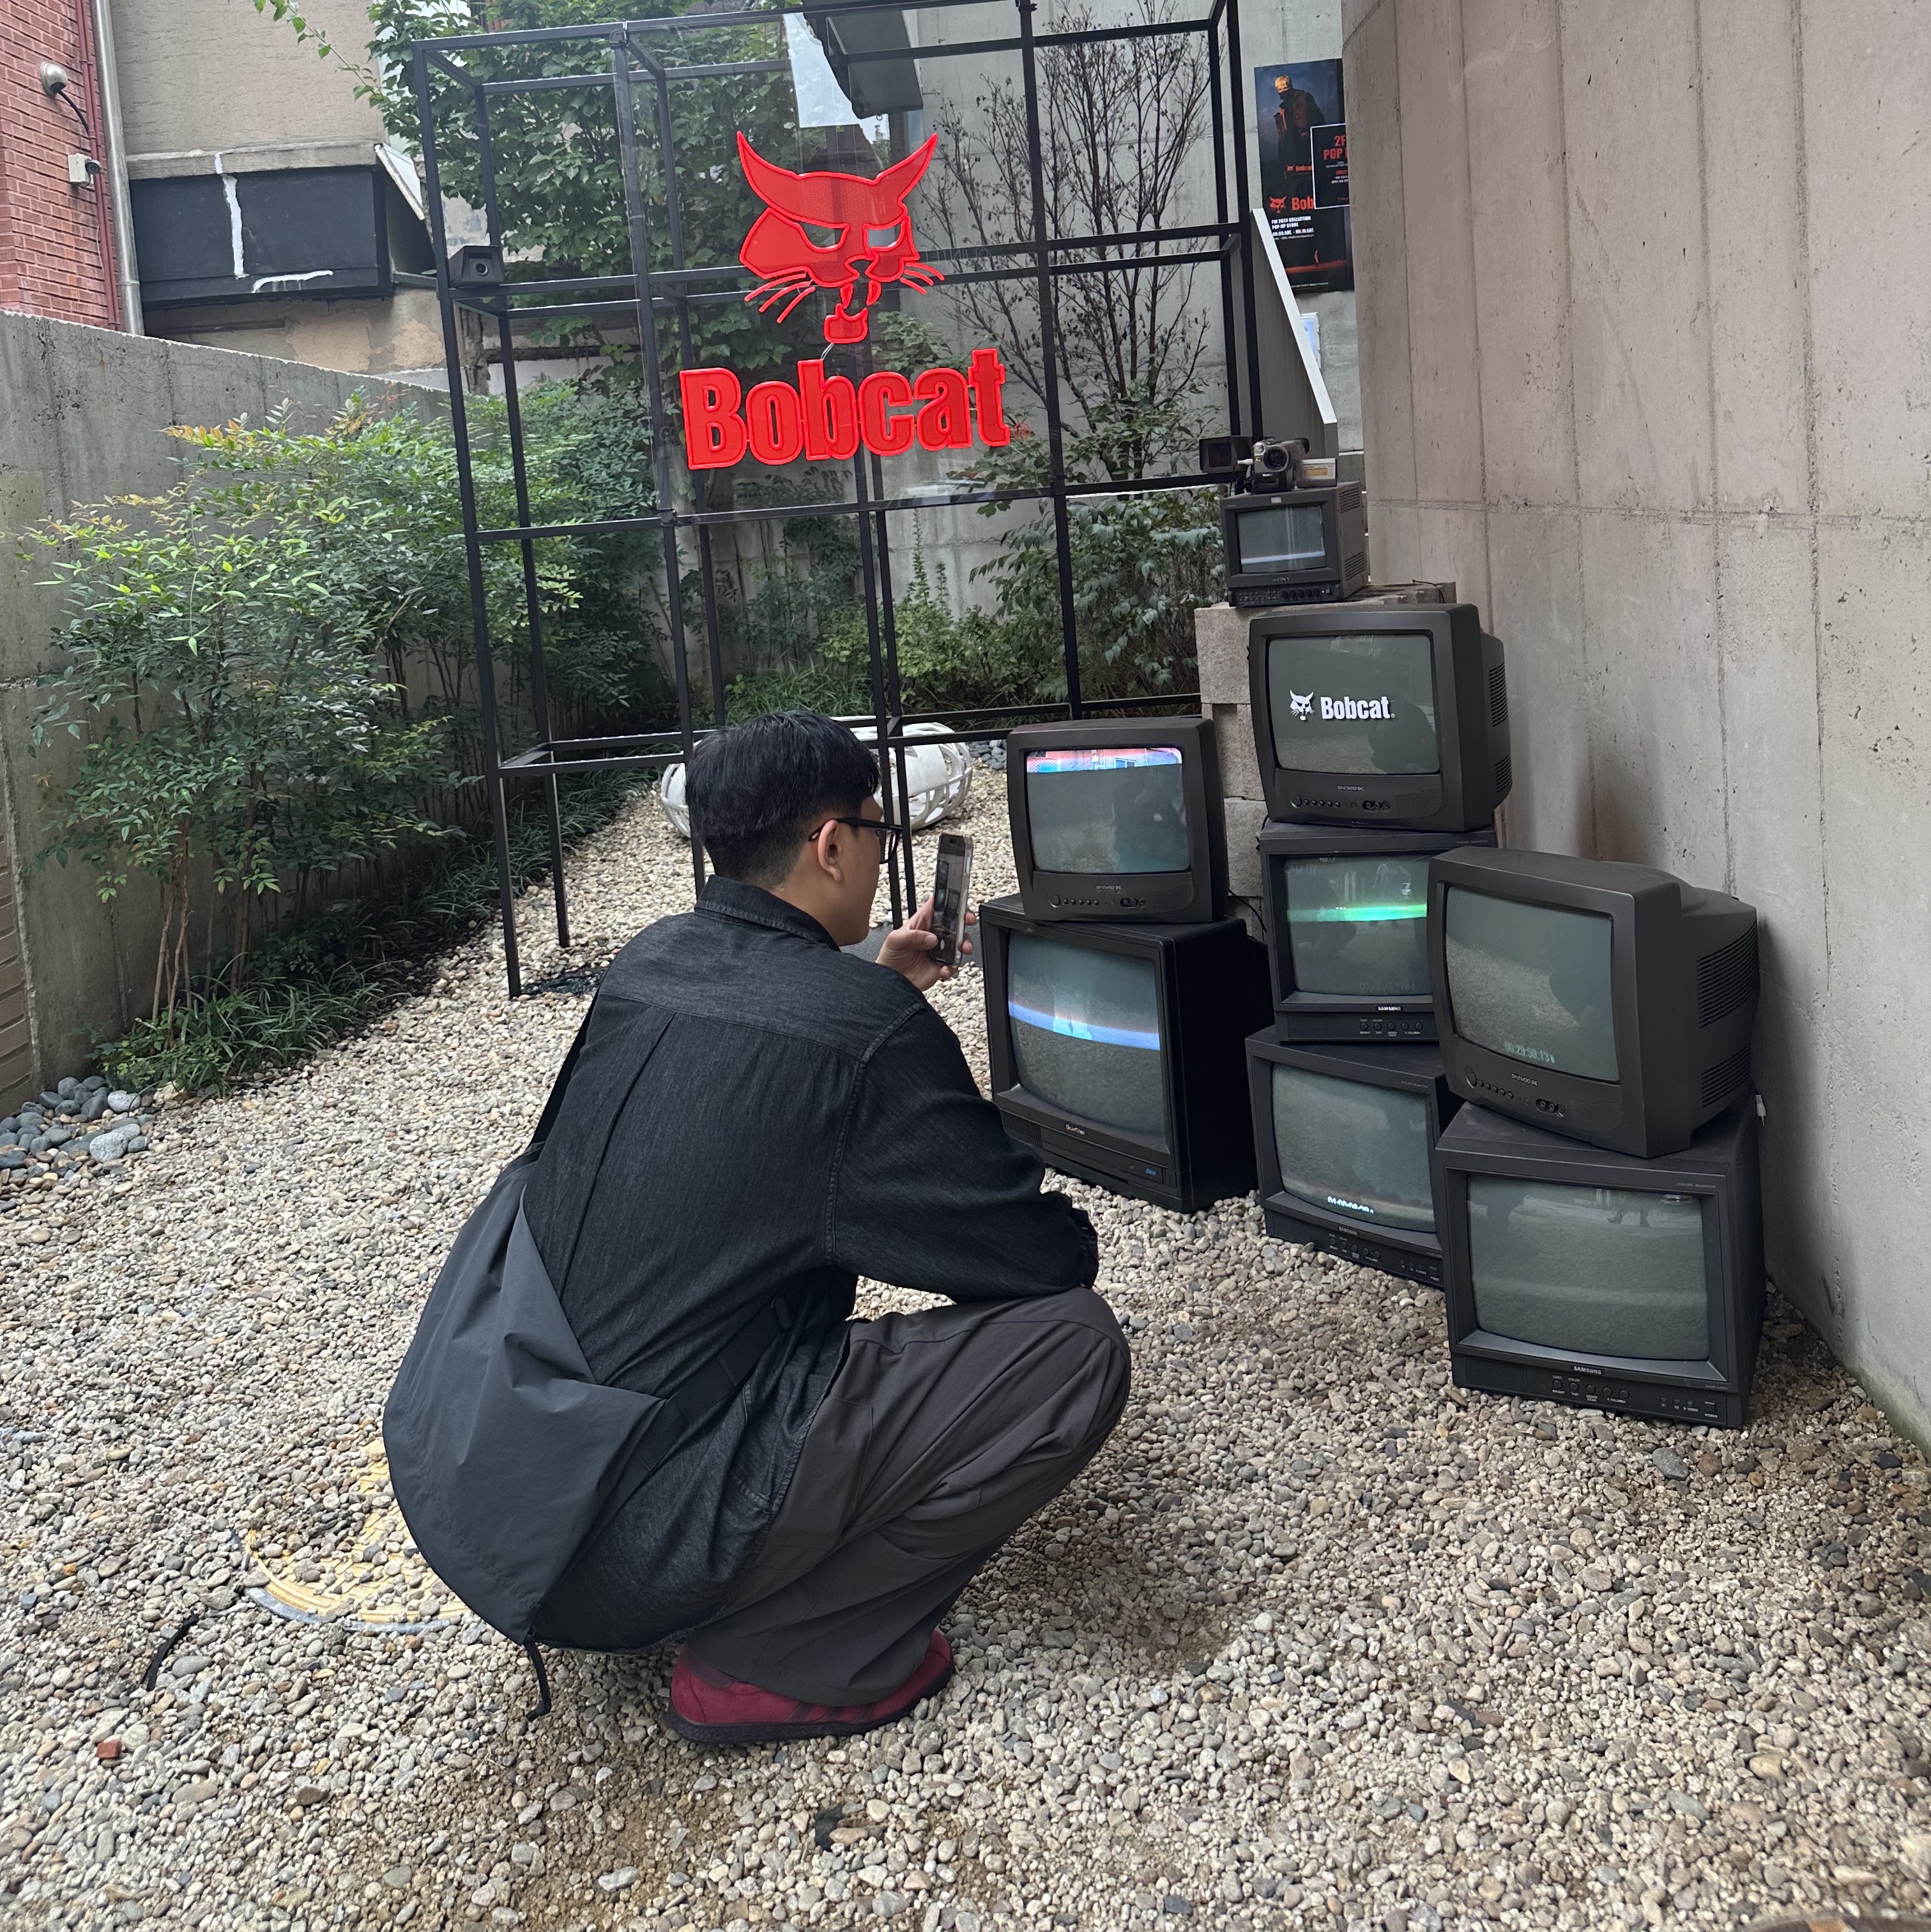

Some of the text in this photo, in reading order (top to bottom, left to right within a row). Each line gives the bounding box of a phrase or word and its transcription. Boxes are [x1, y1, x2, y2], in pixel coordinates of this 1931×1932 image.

[1324, 148, 1342, 160] POP
[680, 348, 1011, 470] Bobcat
[1320, 696, 1390, 719] Bobcat
